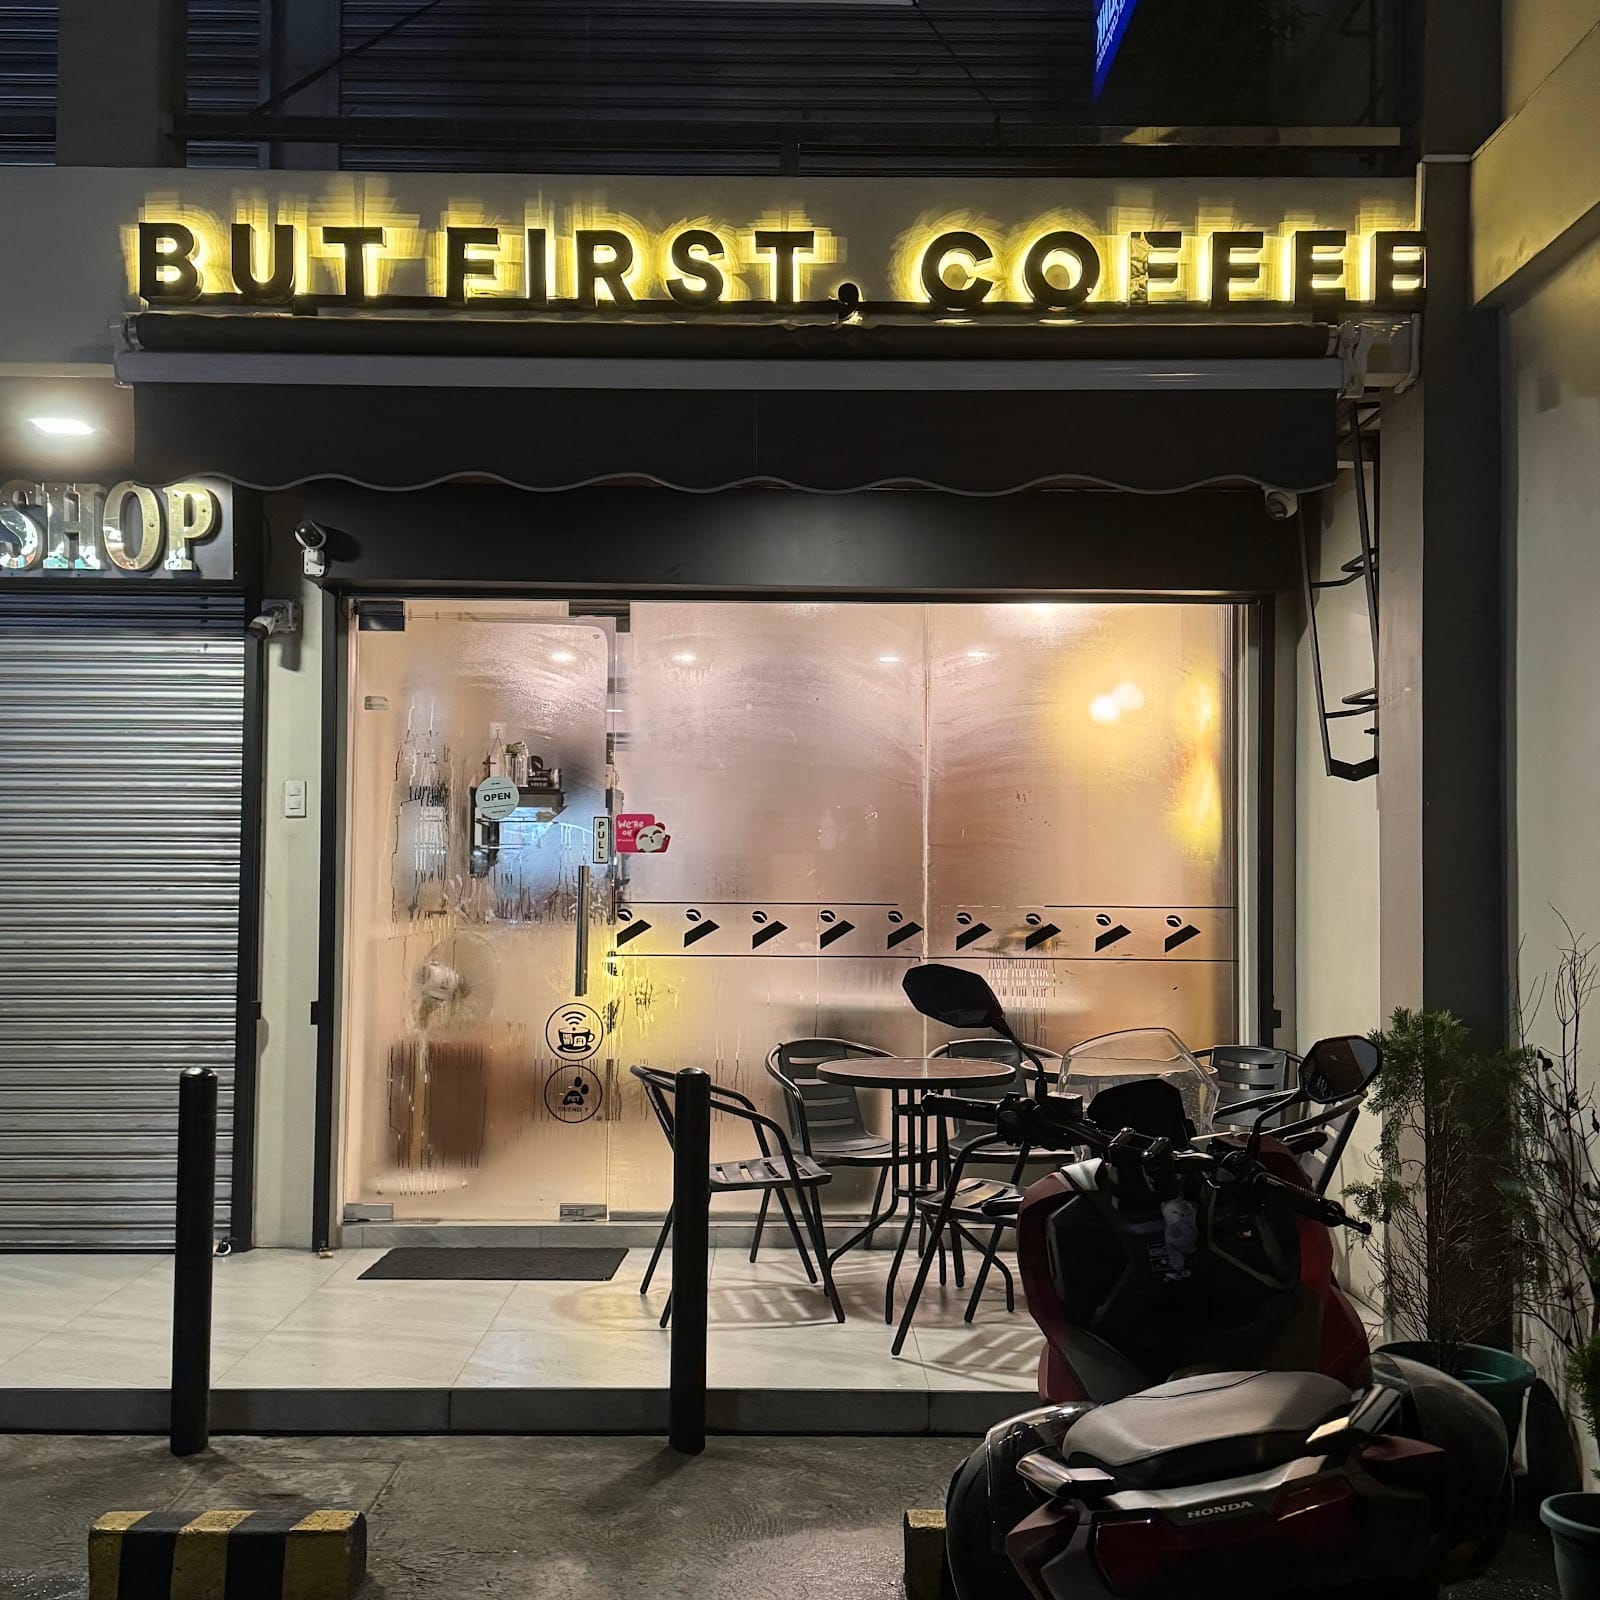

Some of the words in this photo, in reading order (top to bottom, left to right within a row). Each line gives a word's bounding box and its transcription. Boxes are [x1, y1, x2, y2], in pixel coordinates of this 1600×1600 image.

[138, 222, 386, 302] BUT
[446, 226, 860, 318] FIRST,
[921, 230, 1427, 312] COFFEE
[0, 480, 216, 570] SHOP
[483, 792, 511, 802] OPEN
[597, 821, 605, 859] PULL
[1188, 1501, 1254, 1518] HONDA
